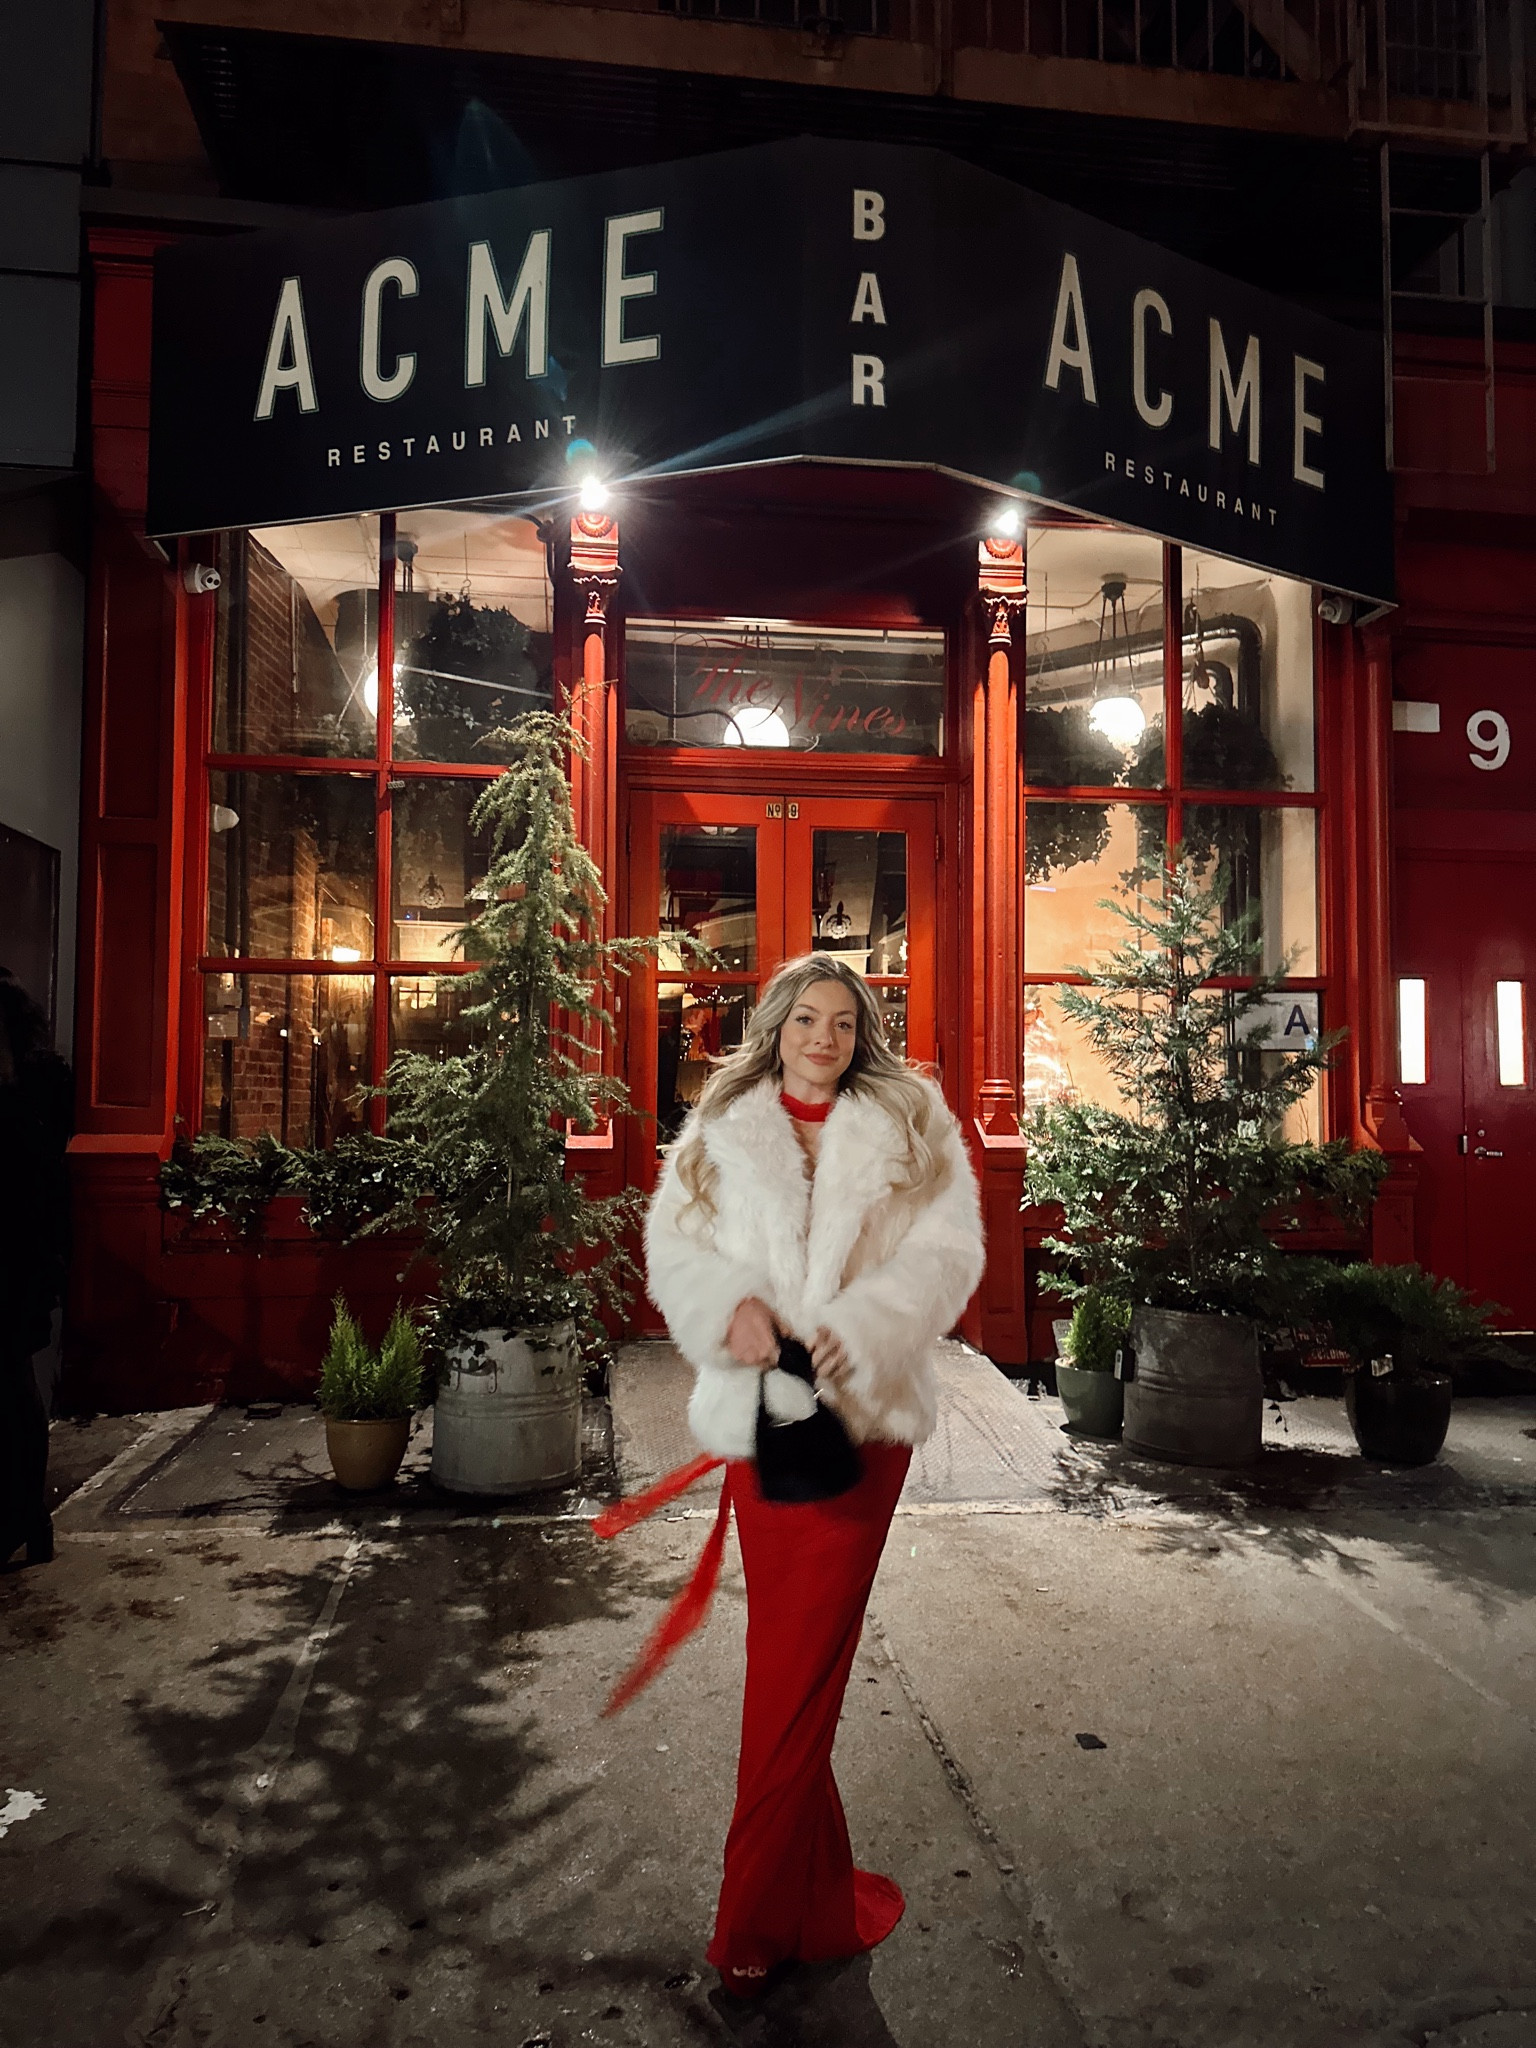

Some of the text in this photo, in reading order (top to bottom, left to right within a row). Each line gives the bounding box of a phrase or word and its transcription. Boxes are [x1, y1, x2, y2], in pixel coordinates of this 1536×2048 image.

[254, 206, 664, 422] ACME
[851, 188, 887, 408] BAR
[1043, 252, 1326, 493] ACME
[327, 415, 576, 467] RESTAURANT
[1105, 451, 1277, 527] RESTAURANT
[676, 633, 908, 737] The Nines
[1466, 709, 1511, 771] 9
[790, 804, 797, 817] 9
[1283, 1004, 1311, 1036] A
